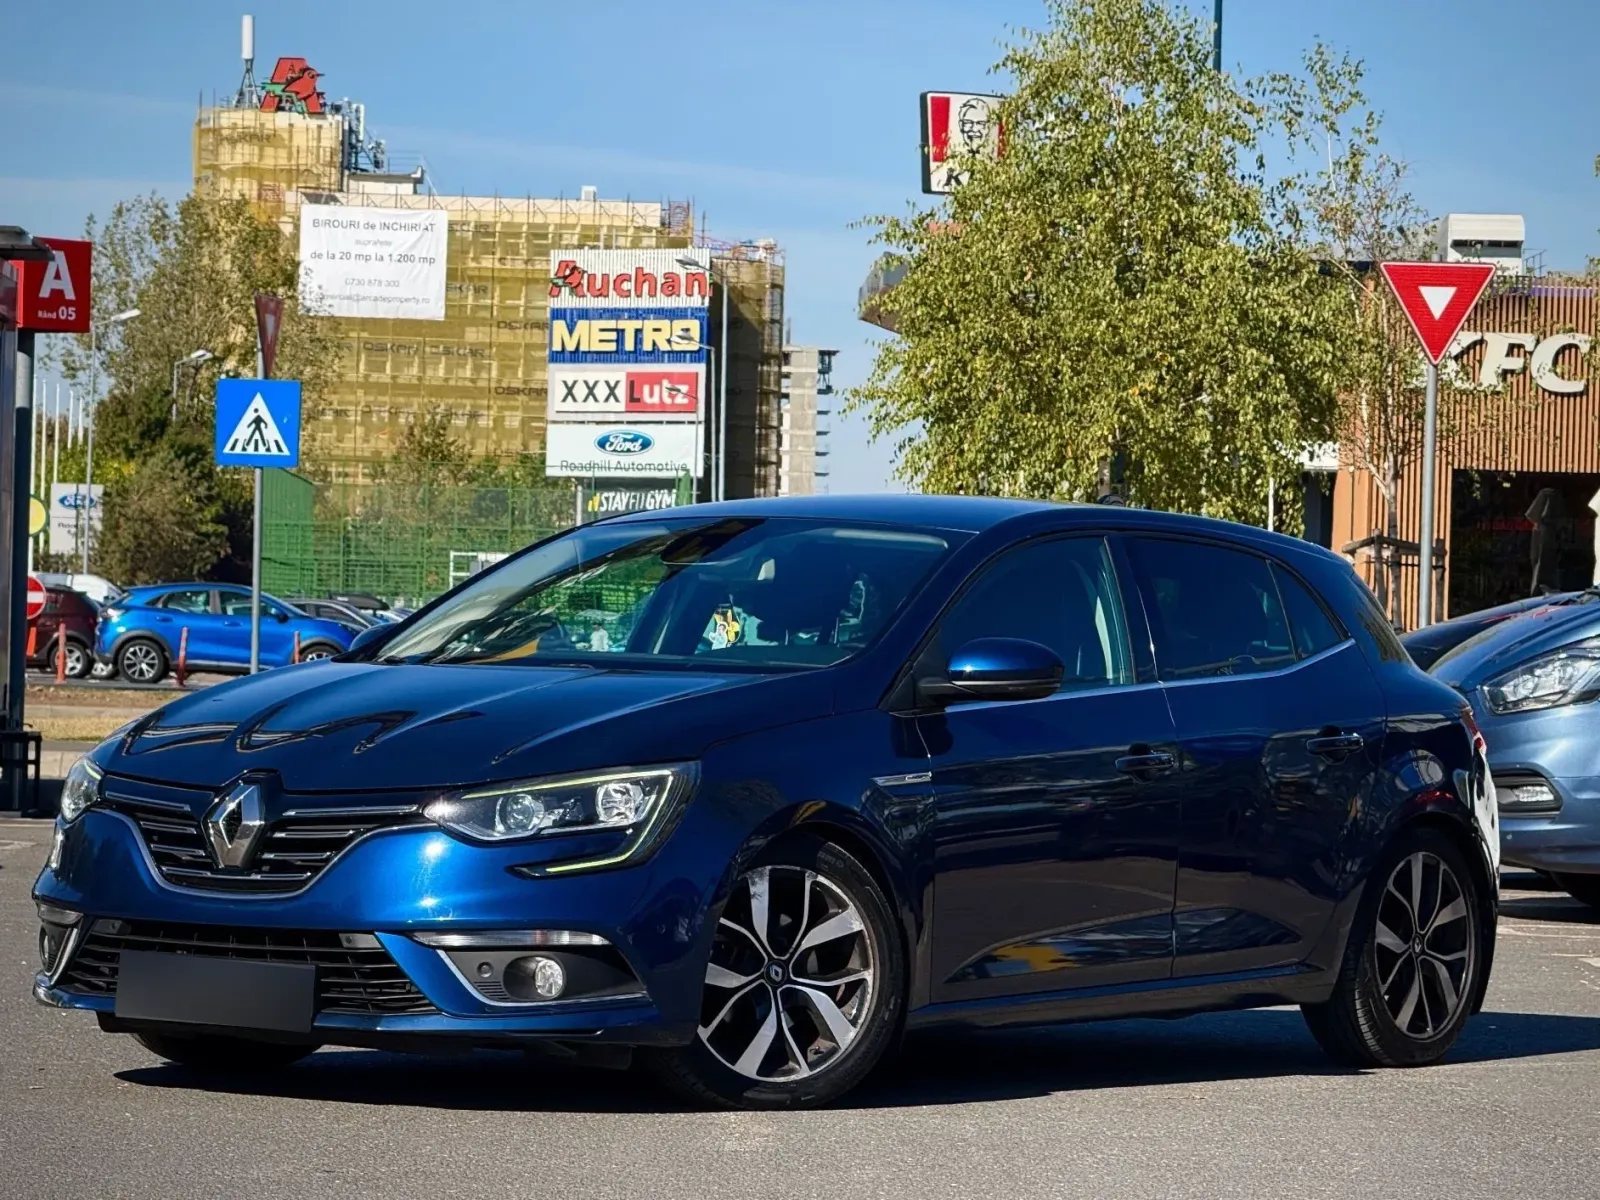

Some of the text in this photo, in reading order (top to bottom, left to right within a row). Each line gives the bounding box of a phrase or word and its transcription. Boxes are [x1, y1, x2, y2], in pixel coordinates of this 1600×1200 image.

[312, 218, 360, 229] BIROURI
[363, 221, 376, 230] de
[310, 250, 436, 266] de la 20 mp la 1.200 mp
[39, 250, 76, 300] A
[549, 260, 707, 298] Auchan
[58, 306, 76, 320] 05
[552, 319, 700, 352] METRO
[605, 433, 643, 453] Ford
[560, 460, 688, 472] Roadhill Automotive
